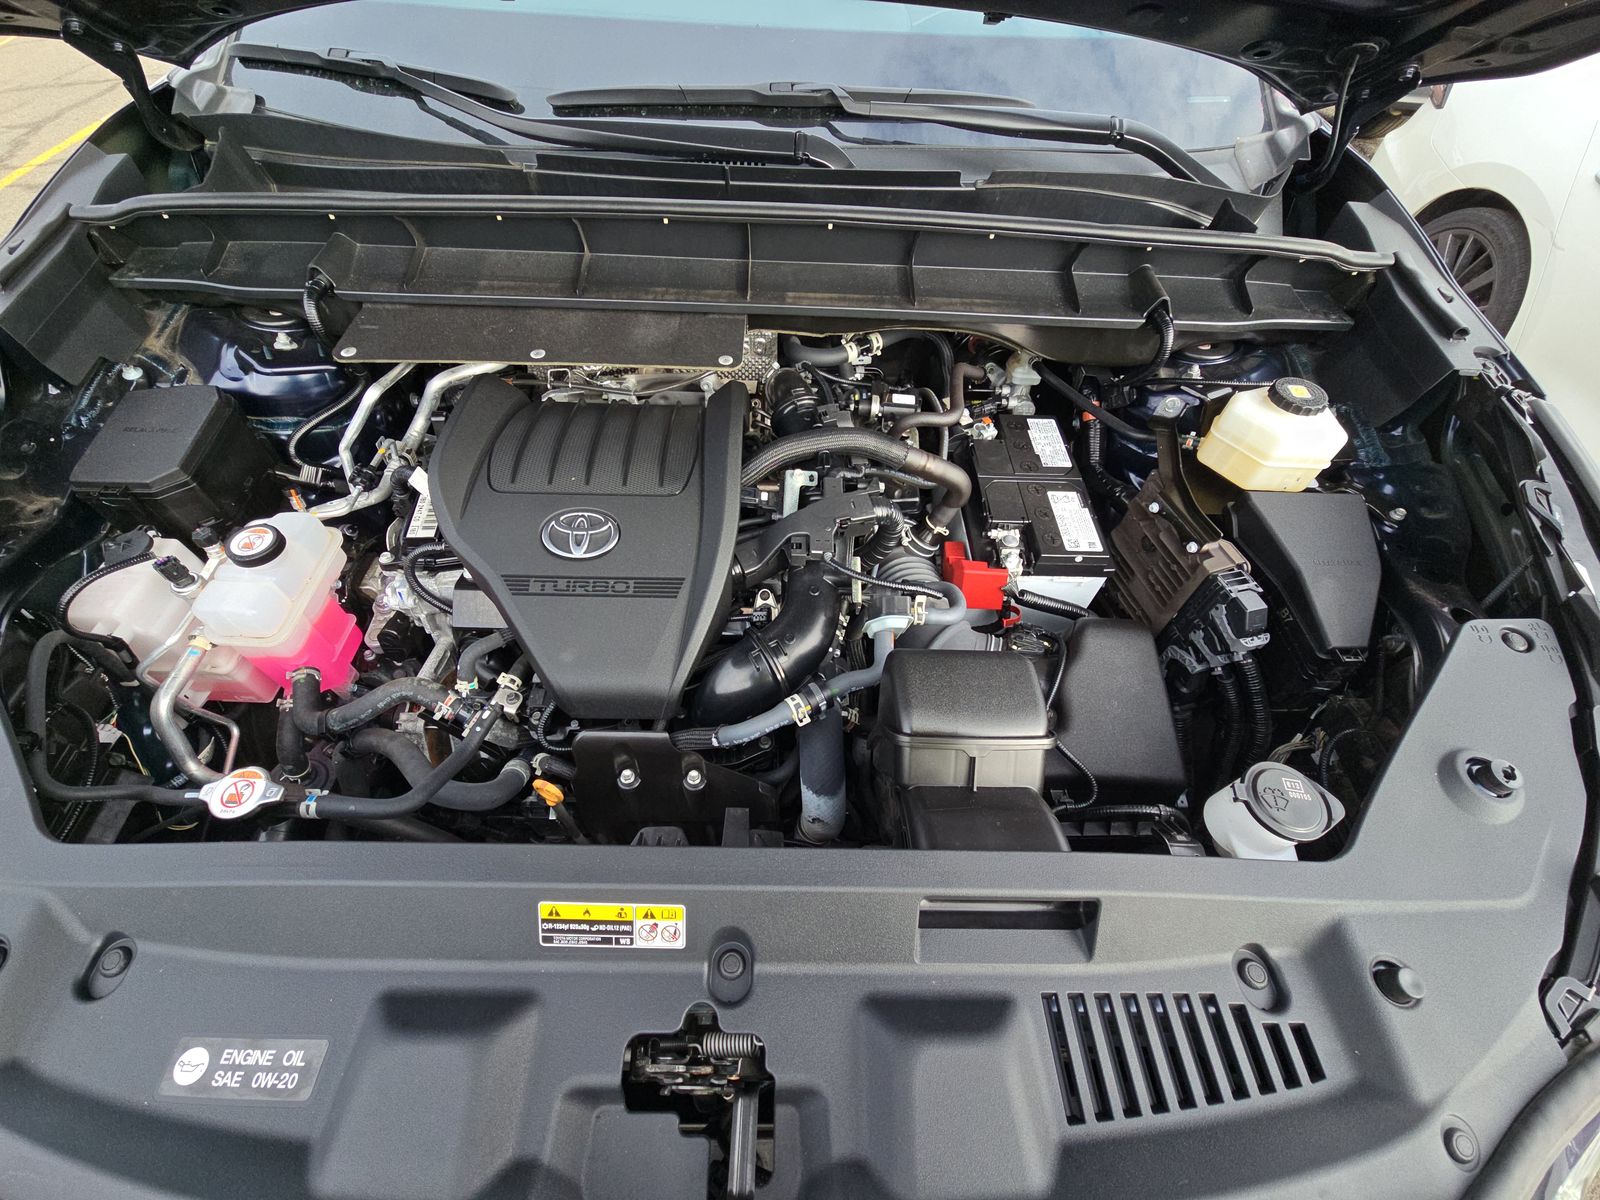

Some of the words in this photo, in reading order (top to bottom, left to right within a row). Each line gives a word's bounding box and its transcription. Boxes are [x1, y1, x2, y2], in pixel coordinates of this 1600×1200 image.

[532, 580, 630, 594] TURBO
[219, 1049, 276, 1066] ENGINE
[282, 1050, 306, 1067] OIL
[211, 1070, 245, 1087] SAE
[251, 1072, 299, 1089] 0W-20
